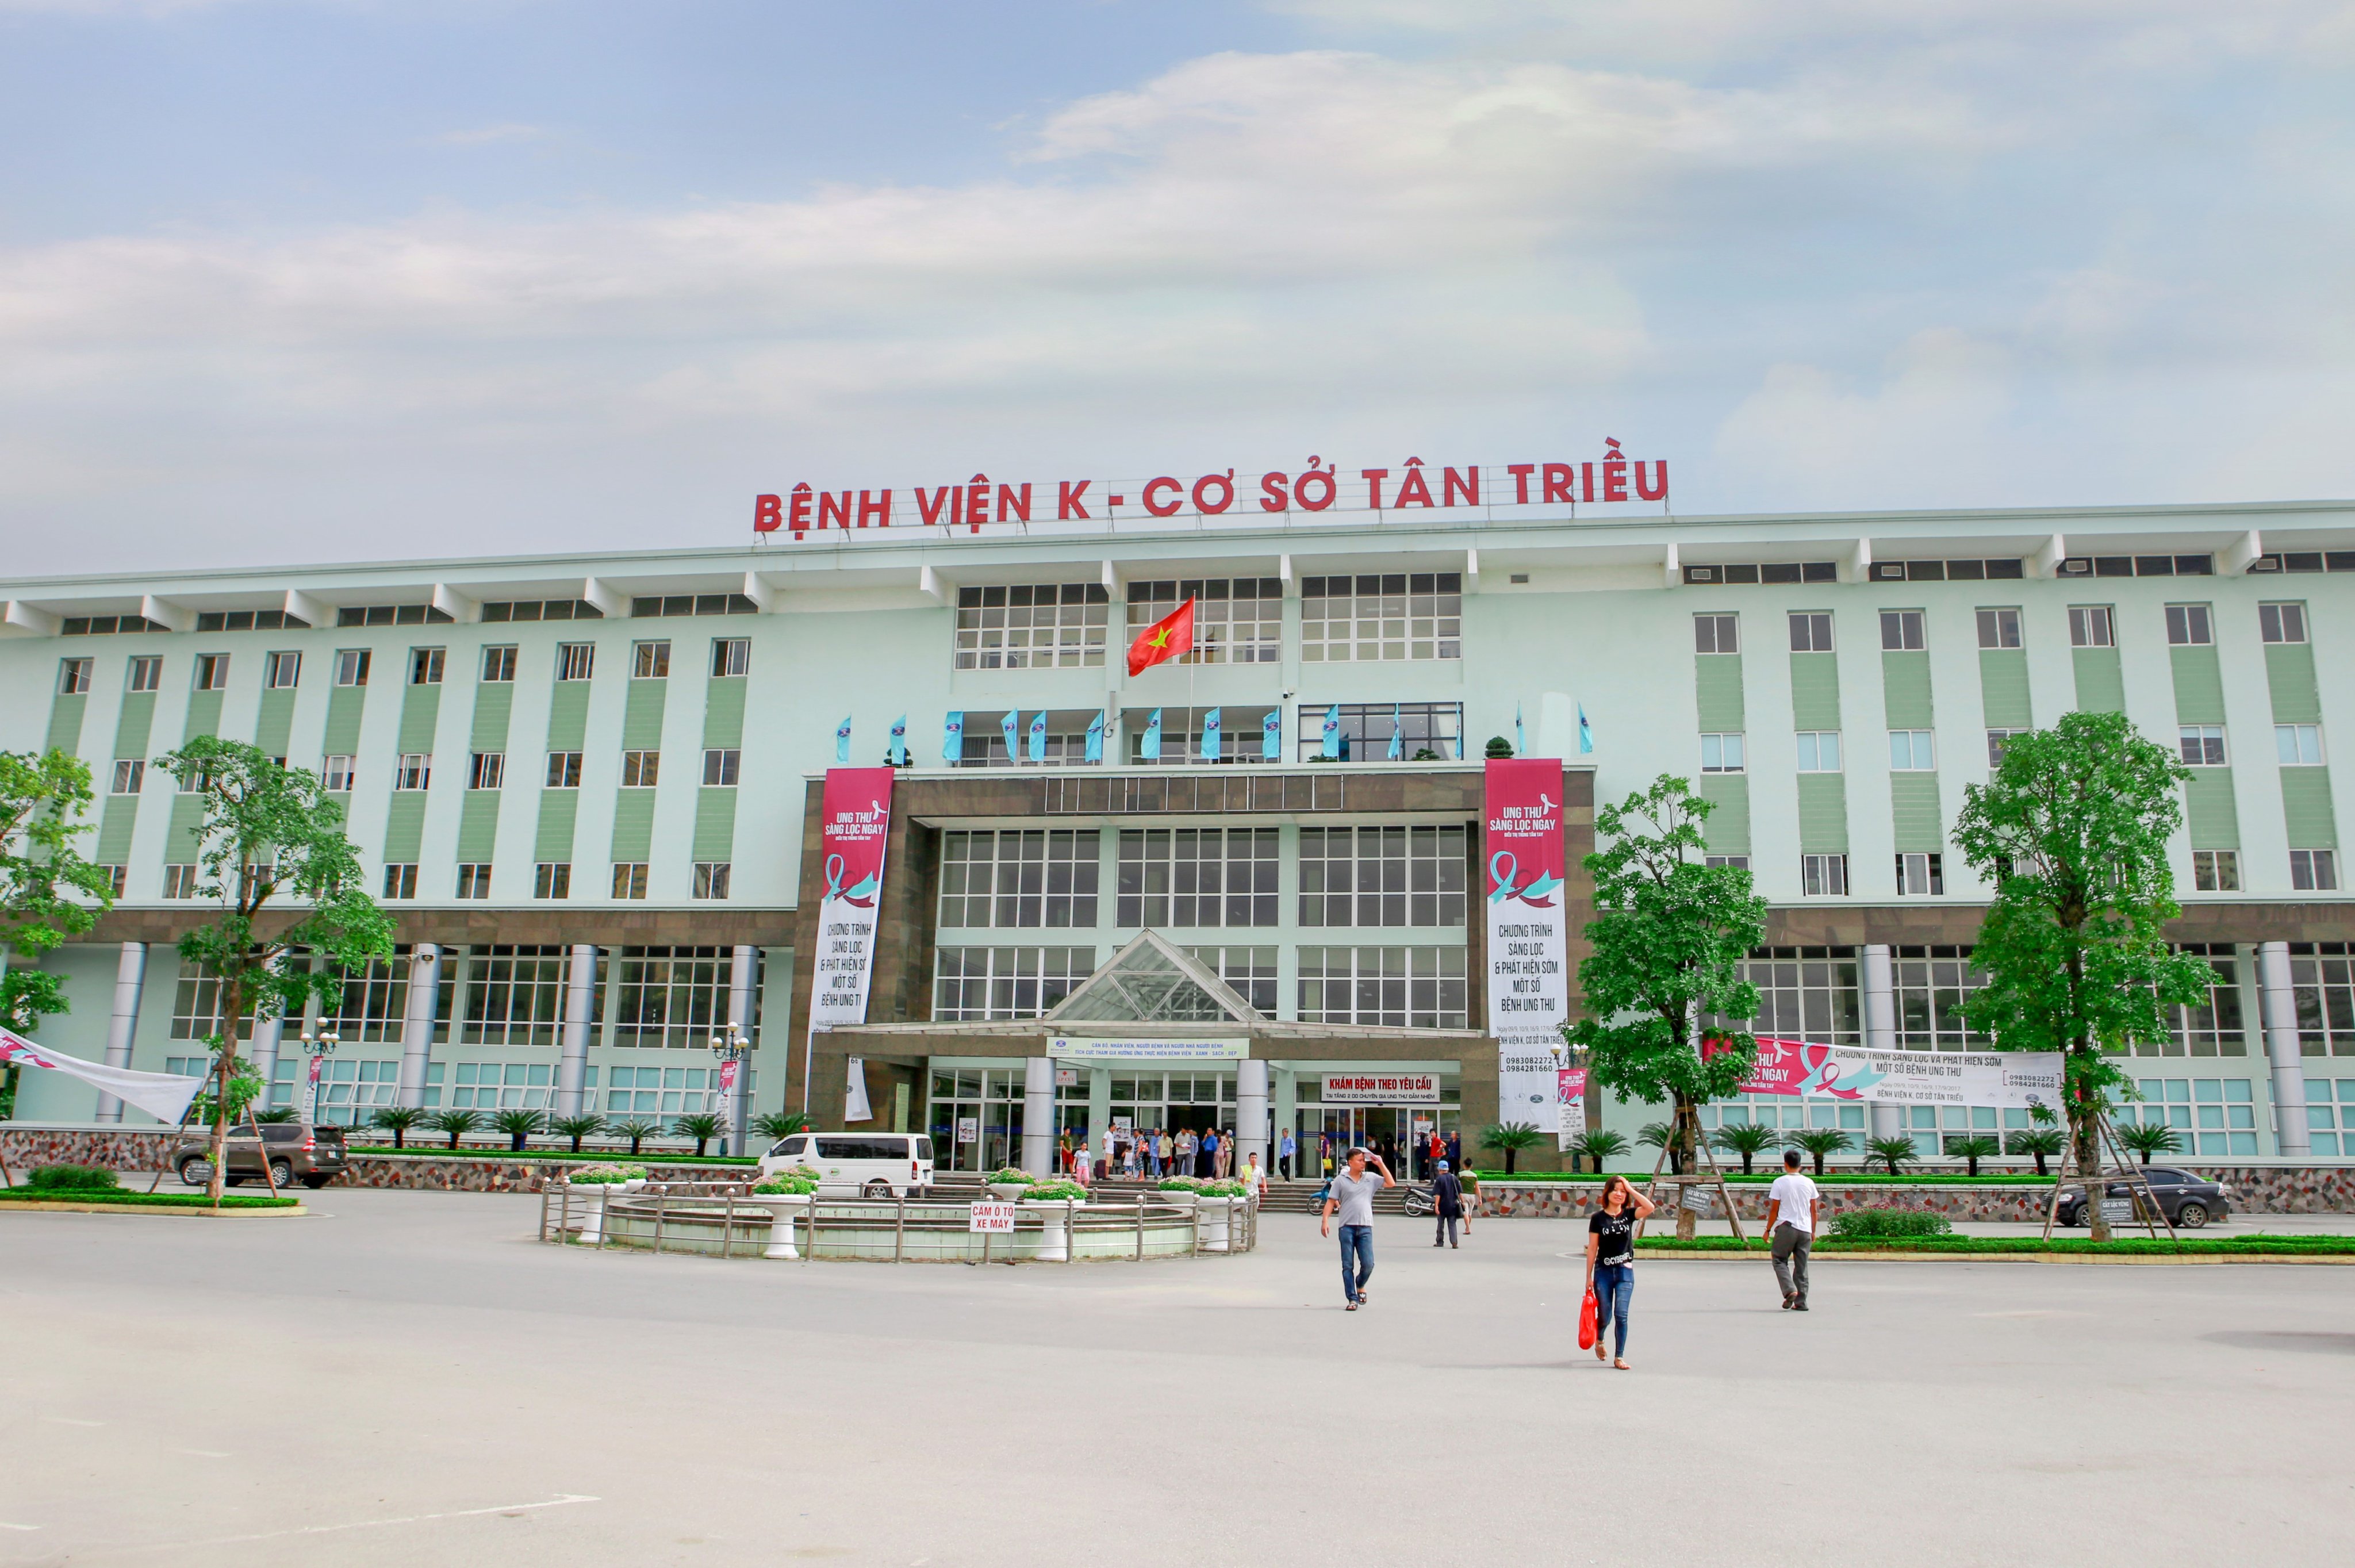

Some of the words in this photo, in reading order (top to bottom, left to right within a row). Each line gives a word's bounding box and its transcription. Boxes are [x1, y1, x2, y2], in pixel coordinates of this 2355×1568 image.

[754, 482, 892, 540] BỆNH
[914, 473, 1031, 534] VIỆN
[1058, 480, 1091, 519] K
[1142, 468, 1234, 517] CƠ
[1260, 455, 1336, 512] SỞ
[1362, 457, 1479, 508] TÂN
[1508, 436, 1667, 504] TRIỀU
[837, 812, 854, 823] UNG
[855, 811, 872, 823] THƯ
[1503, 807, 1522, 819] UNG
[1524, 806, 1543, 819] THƯ
[825, 823, 844, 835] SÀNG
[845, 824, 860, 836] LỌC
[861, 824, 884, 834] NGAY
[1490, 818, 1513, 831] SÀNG
[1514, 819, 1531, 833] LỌC
[1532, 819, 1556, 830] NGAY
[852, 921, 871, 936] TRÌNH
[1499, 924, 1528, 937] CHƯƠNG
[1531, 922, 1552, 937] TRÌNH
[832, 938, 847, 953] SÀNG
[849, 941, 862, 956] LỌC
[1509, 941, 1528, 956] SÀNG
[1530, 942, 1544, 958] LỌC
[820, 959, 825, 971] &
[842, 956, 857, 973] HIỆN
[1495, 961, 1499, 974] &
[1502, 959, 1521, 974] PHÁT
[1523, 959, 1540, 976] HIỆN
[1542, 959, 1558, 973] SỚM
[833, 973, 846, 991] MỘT
[848, 972, 858, 988] SỐ
[1513, 977, 1529, 995] MỘT
[1531, 976, 1541, 992] SỐ
[822, 991, 838, 1008] BỆNH
[840, 994, 854, 1006] UNG
[1502, 996, 1521, 1014] BỆNH
[1524, 998, 1538, 1011] UNG
[1540, 998, 1555, 1011] THƯ
[1509, 1034, 1519, 1046] VIỆN
[1526, 1036, 1532, 1044] CƠ
[1533, 1033, 1539, 1044] SỞ
[1540, 1034, 1549, 1044] TÂN
[1762, 1068, 1789, 1082] NGAY
[1876, 1062, 1892, 1075] MỘT
[1894, 1061, 1905, 1073] SỐ
[1907, 1063, 1926, 1076] BỆNH
[1929, 1065, 1944, 1076] UNG
[1946, 1067, 1961, 1076] THƯ
[1329, 1076, 1352, 1090] KHÁM
[1355, 1076, 1375, 1092] BỆNH
[1378, 1079, 1397, 1090] THEO
[1399, 1076, 1414, 1090] YÊU
[1877, 1090, 1892, 1098] BỆNH
[1894, 1090, 1907, 1099] VIỆN
[1925, 1091, 1932, 1099] SỞ
[1934, 1091, 1944, 1101] TÂN
[973, 1205, 991, 1216] CẤM
[995, 1205, 1000, 1216] Ô
[1003, 1205, 1013, 1217] TÔ
[977, 1219, 987, 1228] XE
[990, 1217, 1009, 1228] MÁY
